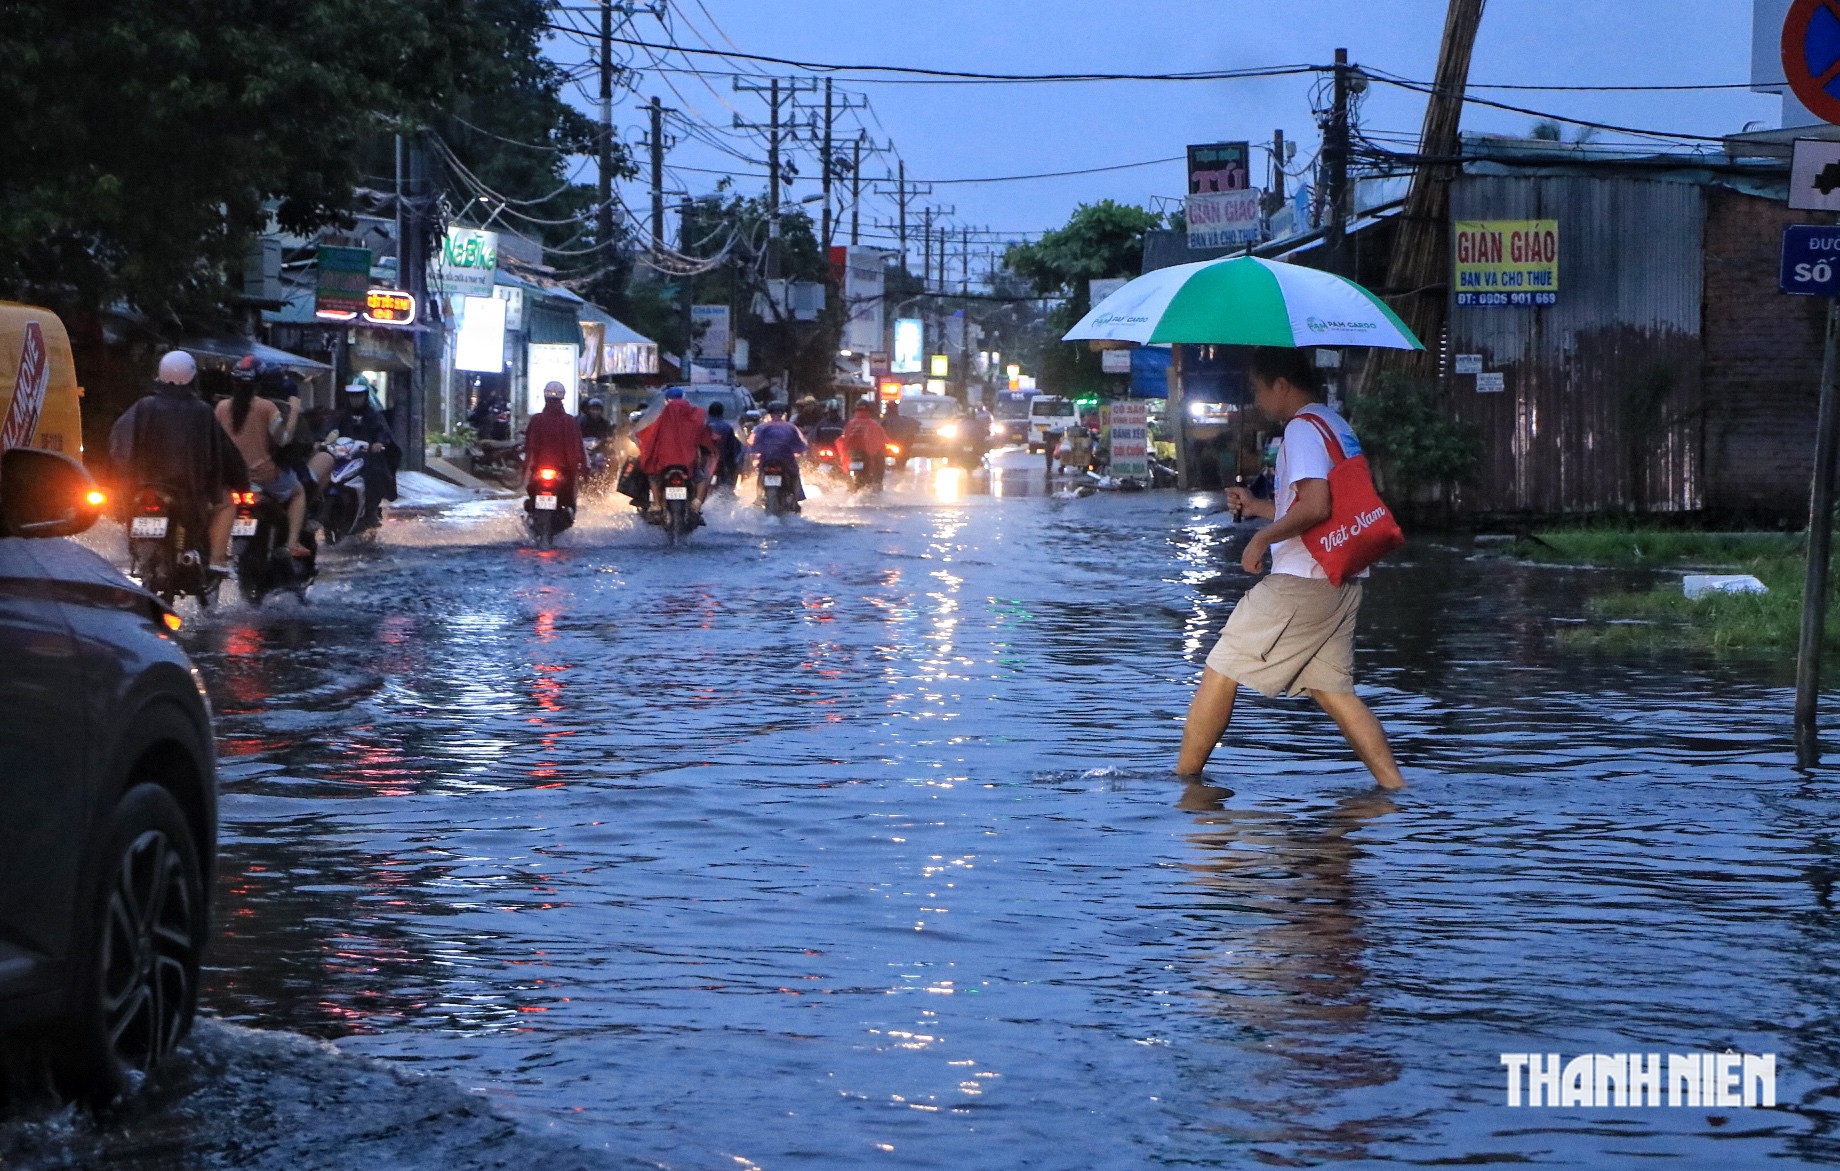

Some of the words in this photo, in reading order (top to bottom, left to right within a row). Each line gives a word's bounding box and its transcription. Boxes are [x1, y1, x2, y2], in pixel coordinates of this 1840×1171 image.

[1457, 223, 1502, 264] GIÀN
[1510, 223, 1556, 264] GIÁO
[1501, 271, 1524, 287] CHO
[1793, 256, 1838, 283] SỐ
[1511, 293, 1532, 304] 901
[1535, 292, 1556, 304] 669
[1347, 321, 1377, 329] CARGO
[1319, 524, 1349, 553] Việt
[1350, 506, 1386, 536] Nam
